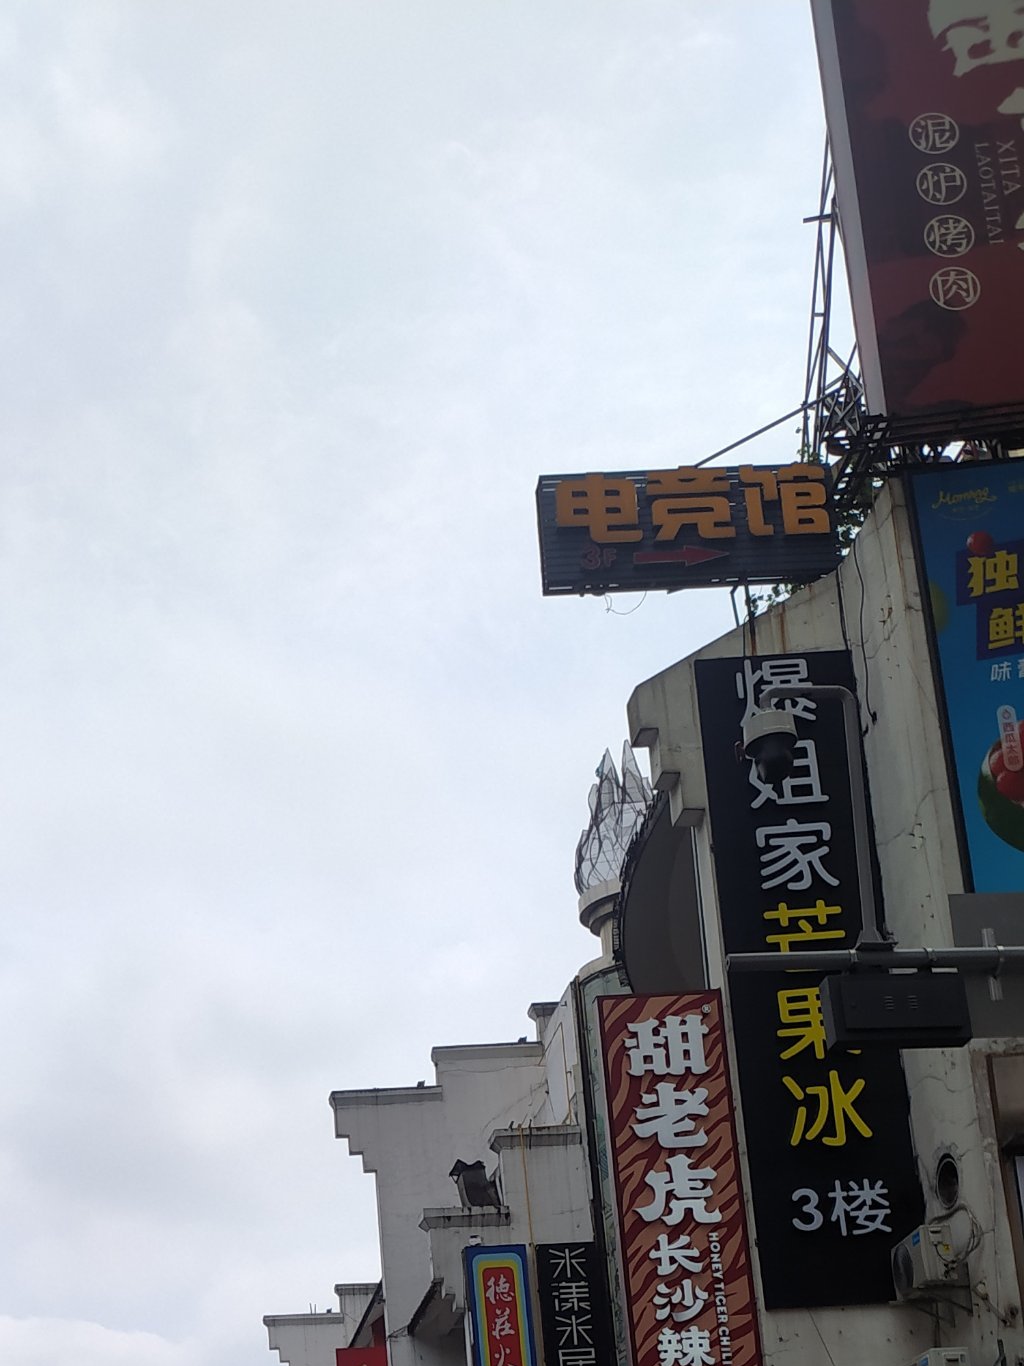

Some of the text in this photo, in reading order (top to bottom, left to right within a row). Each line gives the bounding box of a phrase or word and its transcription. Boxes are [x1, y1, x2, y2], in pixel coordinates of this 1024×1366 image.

[974, 142, 1005, 246] LAOTAITAI
[996, 139, 1022, 196] XITA
[911, 114, 979, 309] 泥炉烤肉
[555, 464, 831, 543] 电竞馆
[580, 546, 617, 569] 3F
[791, 1178, 892, 1238] 3楼
[708, 1231, 724, 1280] HONEY
[714, 1281, 729, 1323] TIGER
[718, 1326, 733, 1366] CHILI
